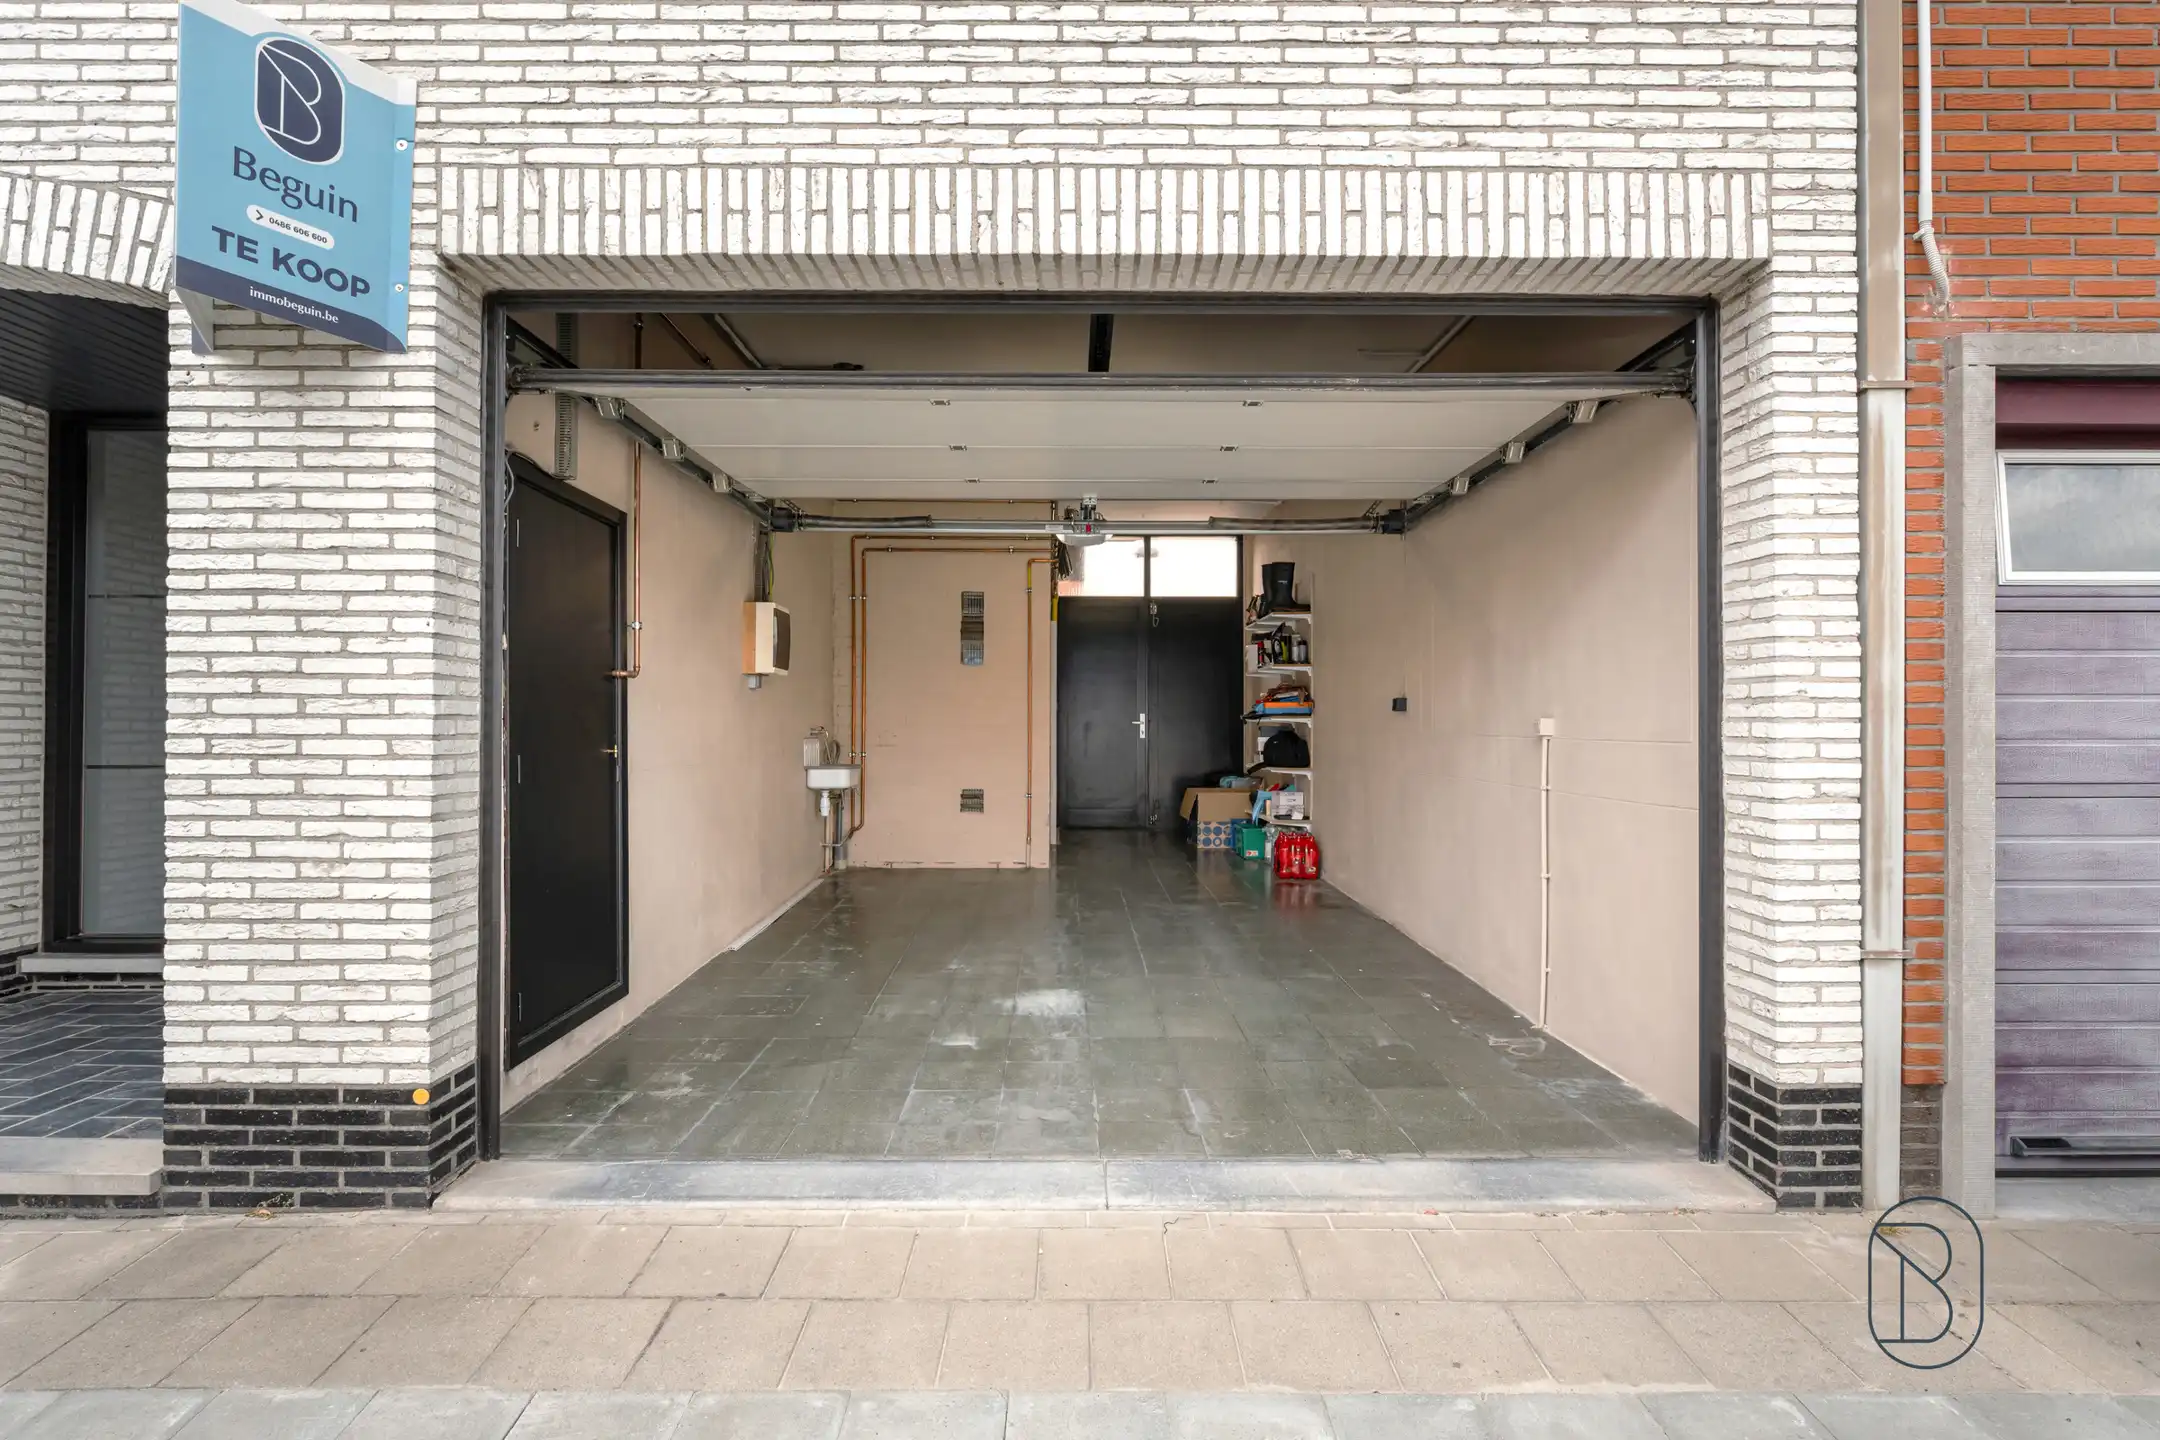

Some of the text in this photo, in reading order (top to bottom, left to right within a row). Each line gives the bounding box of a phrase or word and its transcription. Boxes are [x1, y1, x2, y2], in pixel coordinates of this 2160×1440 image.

[232, 145, 359, 223] Beguin
[268, 216, 328, 244] 0486 606 600
[211, 225, 371, 298] TE KOOP
[249, 285, 340, 324] immobeguin.be
